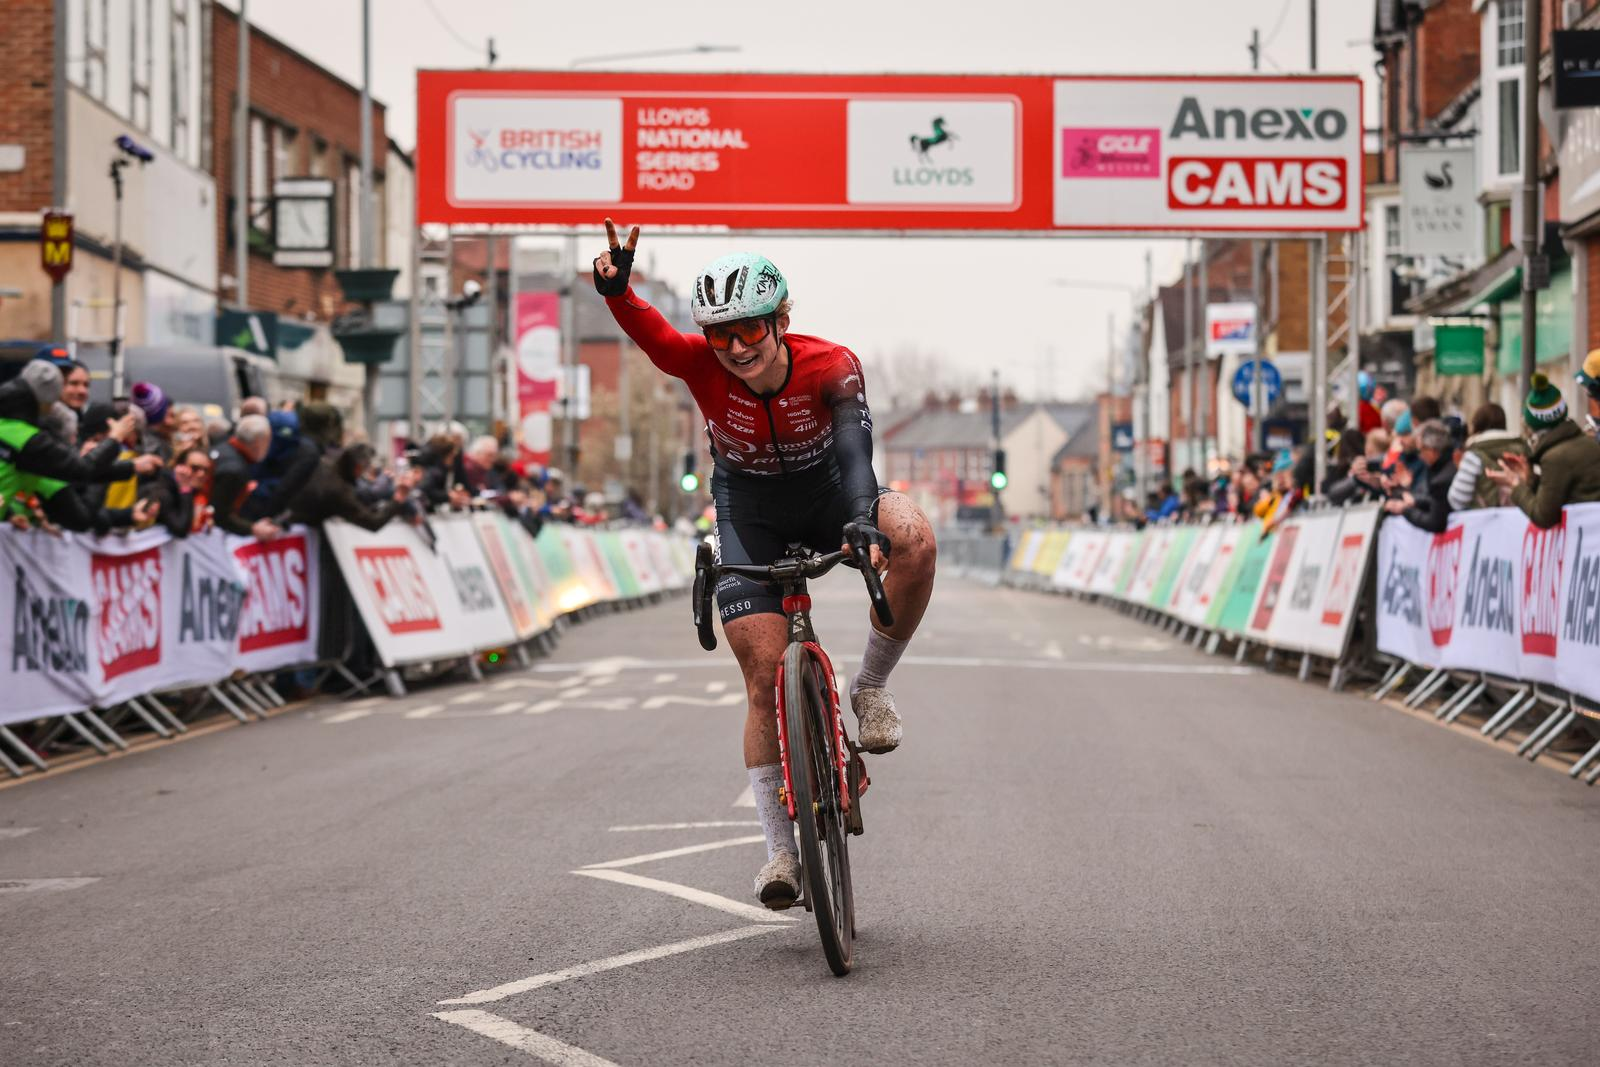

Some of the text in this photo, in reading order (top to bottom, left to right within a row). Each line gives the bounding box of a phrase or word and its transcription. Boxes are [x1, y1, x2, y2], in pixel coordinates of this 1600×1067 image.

[637, 108, 710, 126] LLOYDS
[1169, 97, 1347, 141] Anexo
[501, 130, 601, 149] BRITISH
[637, 129, 748, 148] NATIONAL
[500, 151, 601, 170] CYCLING
[637, 152, 720, 171] SERIES
[637, 173, 695, 191] ROAD
[893, 168, 974, 186] LLOYDS
[1170, 161, 1343, 206] CAMS
[45, 241, 71, 265] M
[736, 264, 750, 302] LAZER
[711, 307, 730, 315] LAZER
[727, 408, 755, 421] wahoo
[726, 420, 756, 434] LAZER
[1461, 534, 1514, 635] Anexo
